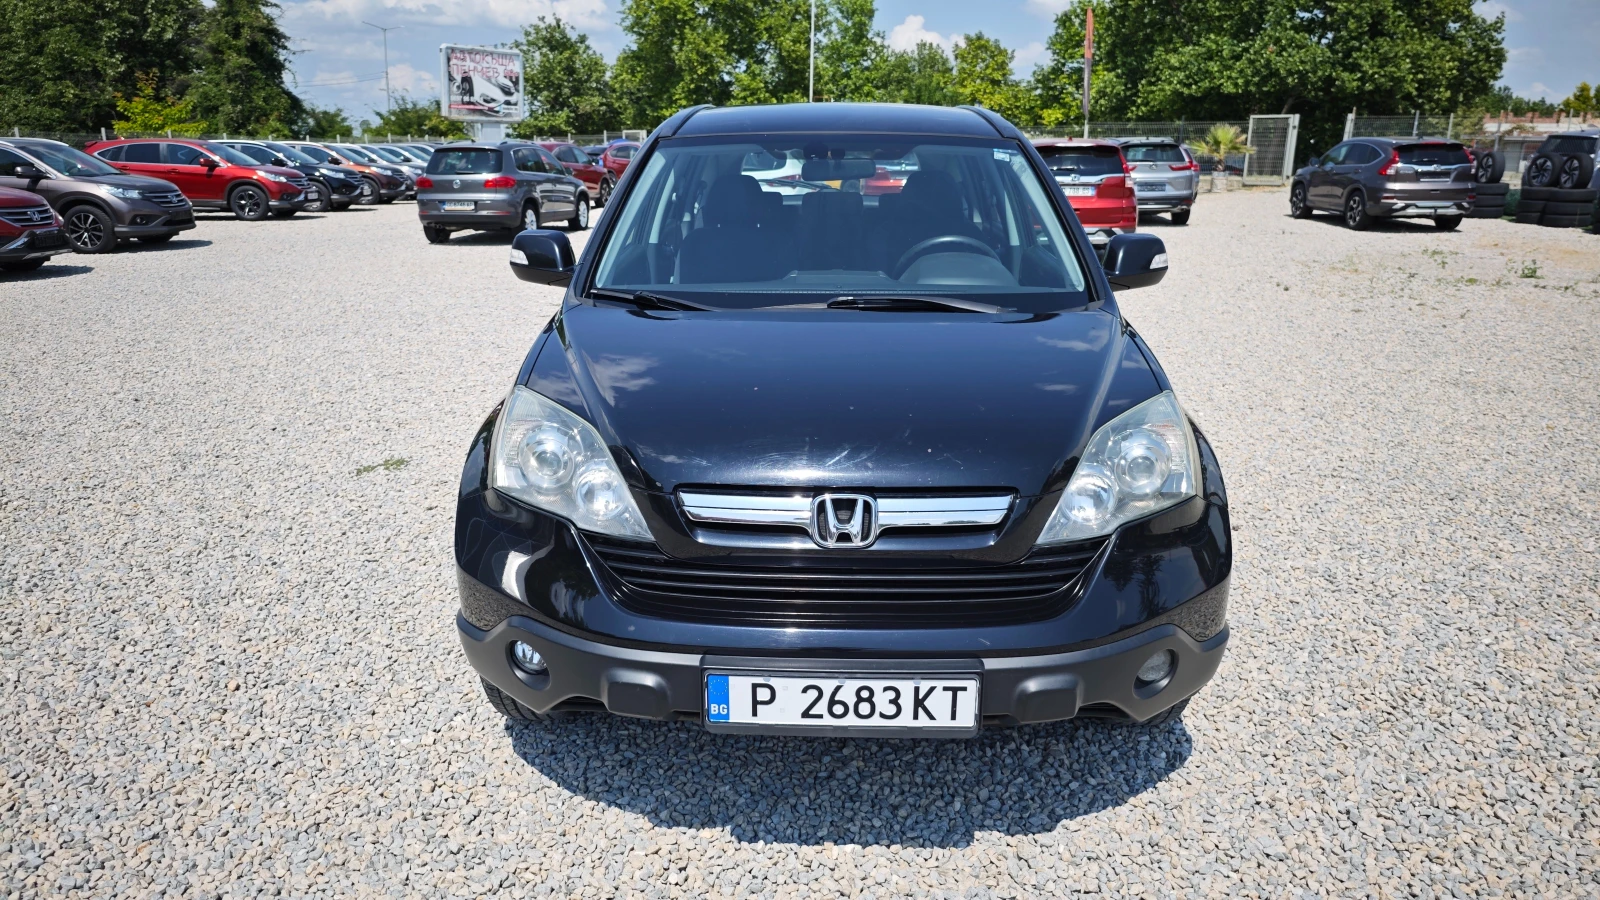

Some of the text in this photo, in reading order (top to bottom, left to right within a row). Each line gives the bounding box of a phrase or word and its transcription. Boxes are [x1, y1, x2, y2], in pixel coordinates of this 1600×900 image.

[710, 703, 728, 715] BG
[752, 682, 968, 721] P 2683 KT
